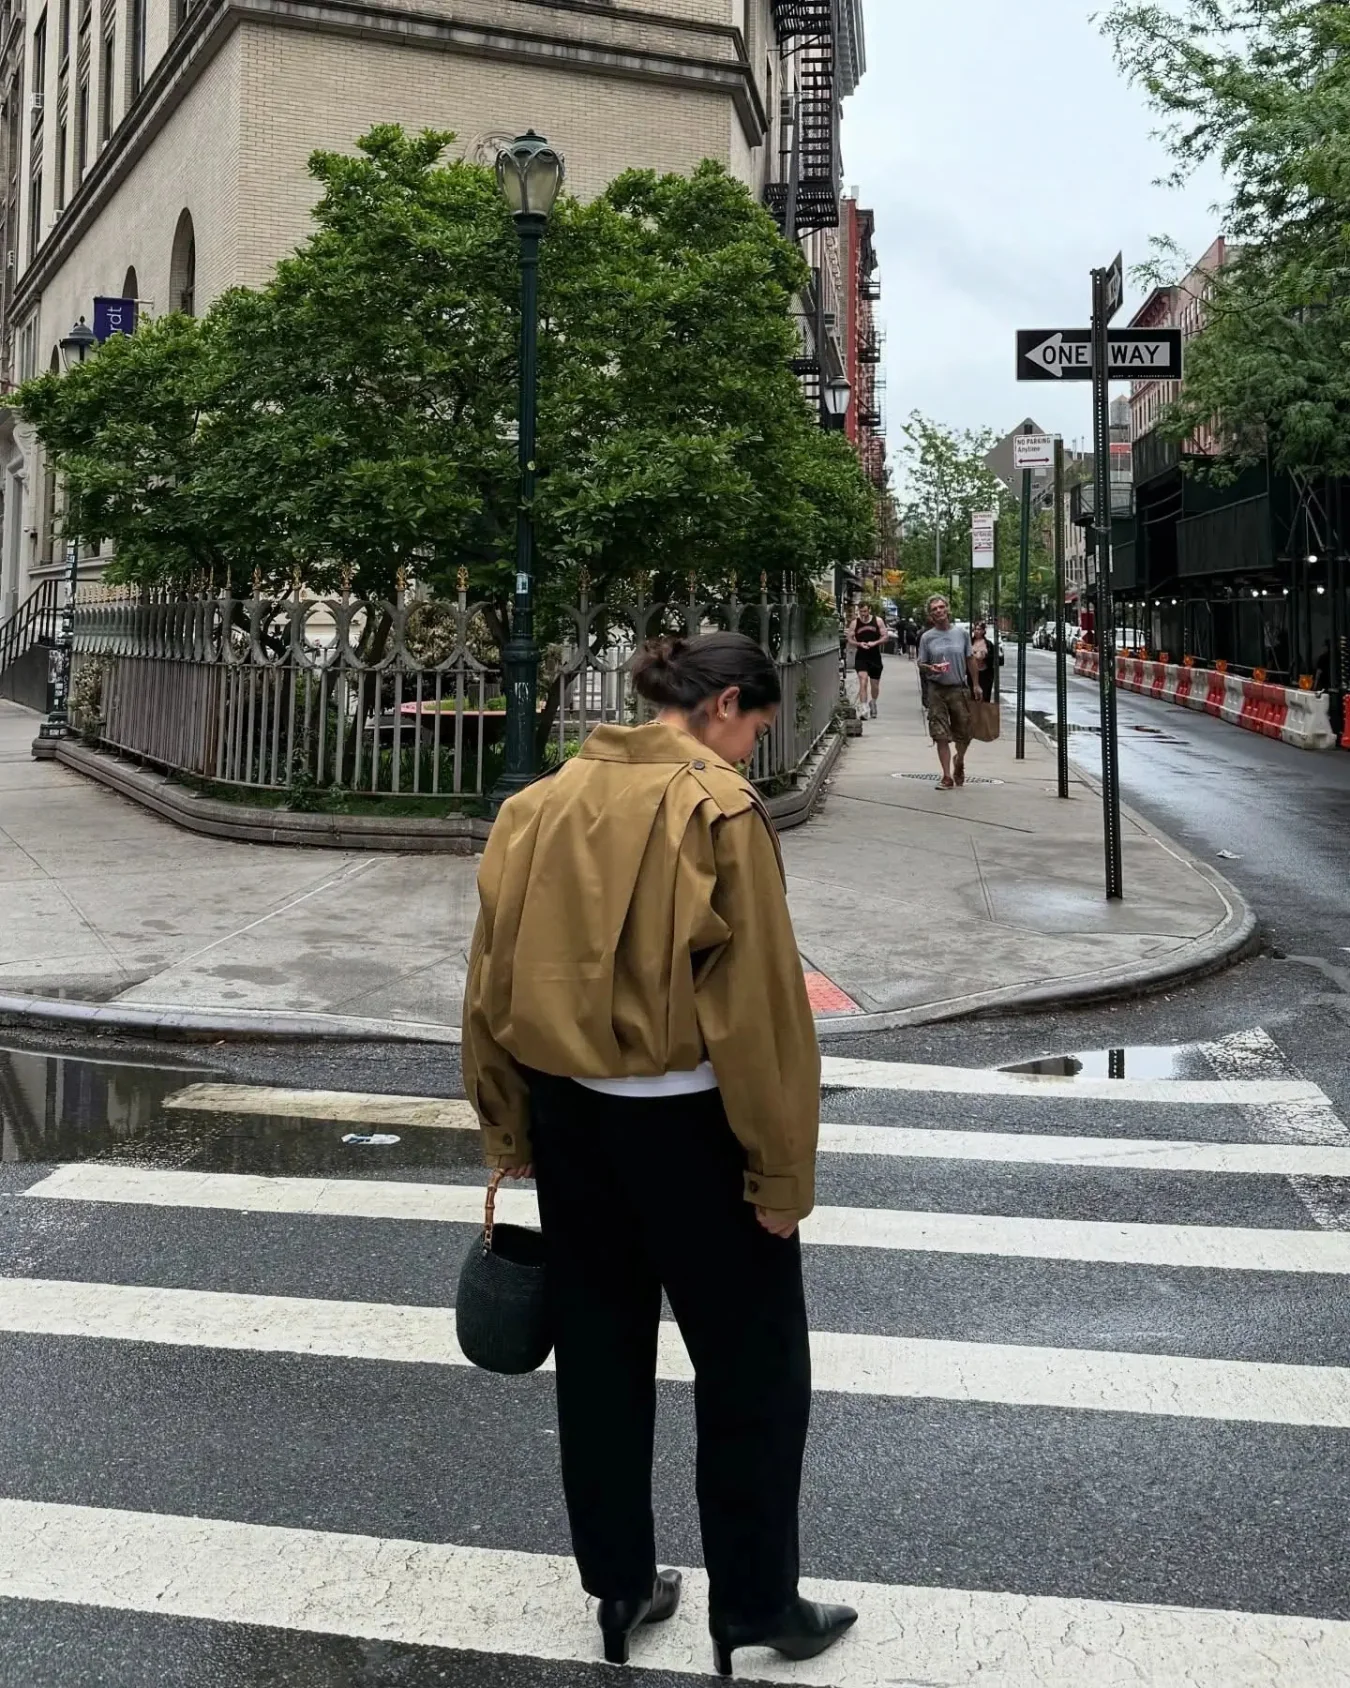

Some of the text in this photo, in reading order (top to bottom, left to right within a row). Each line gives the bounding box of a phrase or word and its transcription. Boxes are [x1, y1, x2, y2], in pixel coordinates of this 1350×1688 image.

[1042, 345, 1160, 364] ONE WAY
[1026, 437, 1051, 445] PARKING
